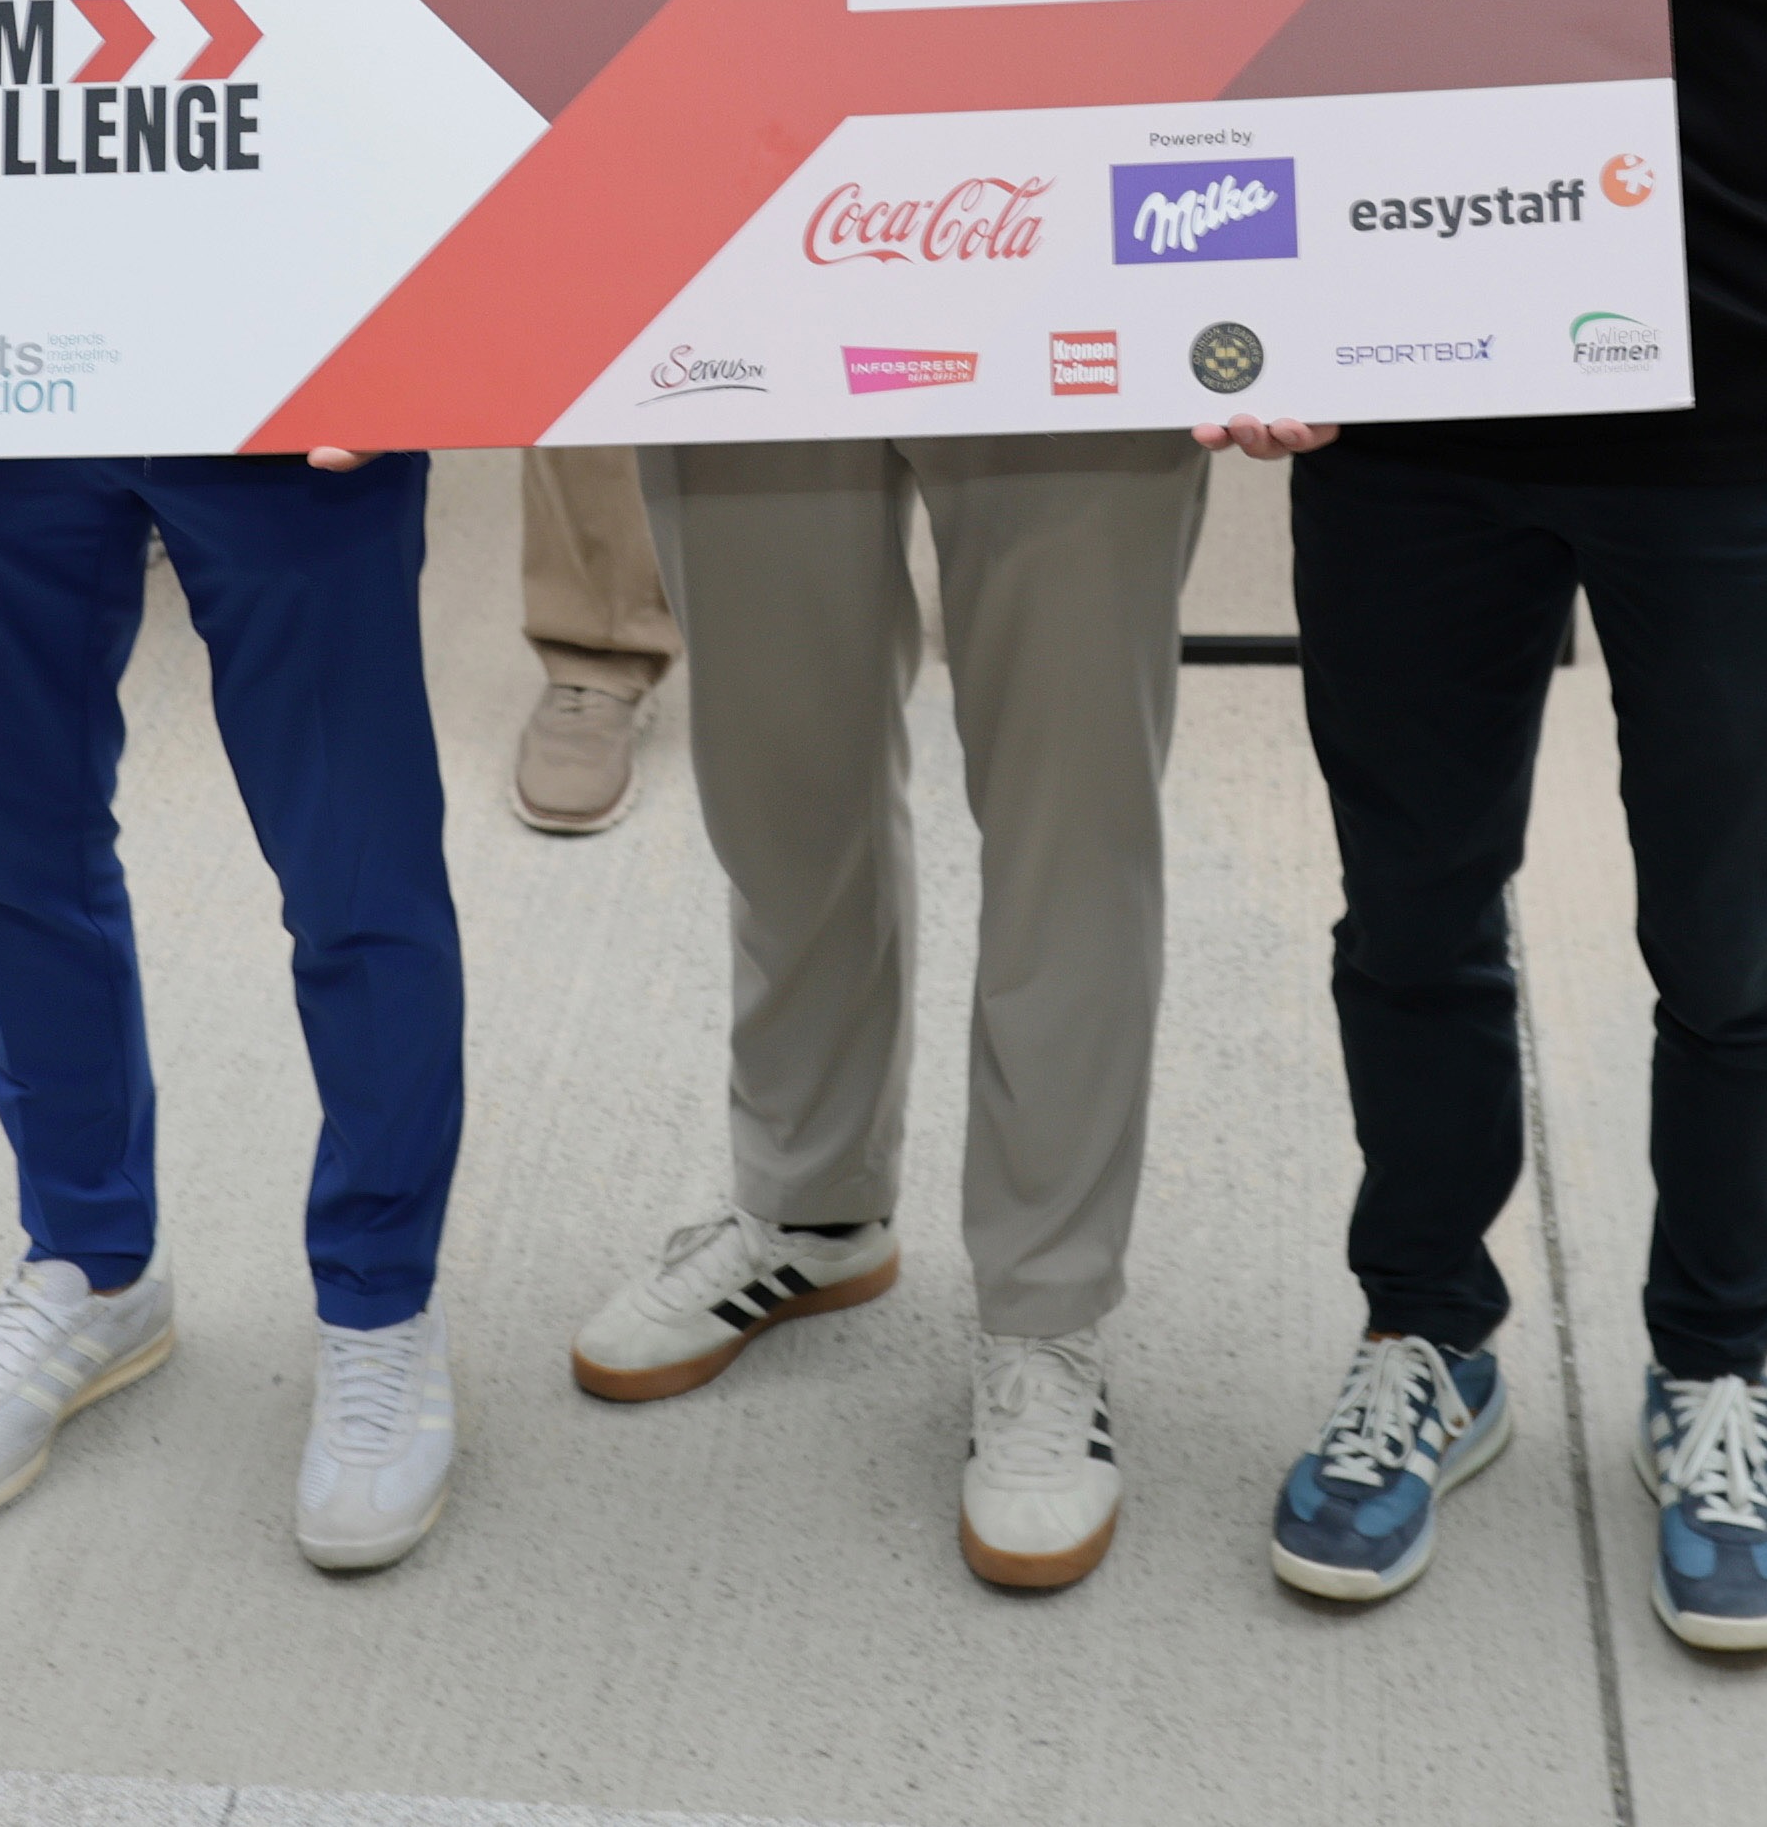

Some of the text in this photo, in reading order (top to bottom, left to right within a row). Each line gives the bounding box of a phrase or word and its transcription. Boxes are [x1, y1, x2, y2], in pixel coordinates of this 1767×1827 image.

[1148, 128, 1253, 149] Powered by
[1134, 174, 1278, 256] Milka
[1349, 178, 1586, 239] easystaff
[802, 175, 1057, 266] Coca-Cola
[46, 331, 107, 349] legends
[1594, 326, 1660, 344] Wiener
[46, 347, 123, 364] marketing
[1052, 340, 1117, 361] Kronen
[1193, 326, 1221, 366] OPINION
[1335, 334, 1496, 365] SPORTBOX
[1572, 341, 1661, 363] Firmen
[46, 361, 98, 374] events
[849, 359, 972, 375] INFOSCREEN
[1053, 361, 1116, 387] Zeitung
[1200, 375, 1254, 390] NETWORK
